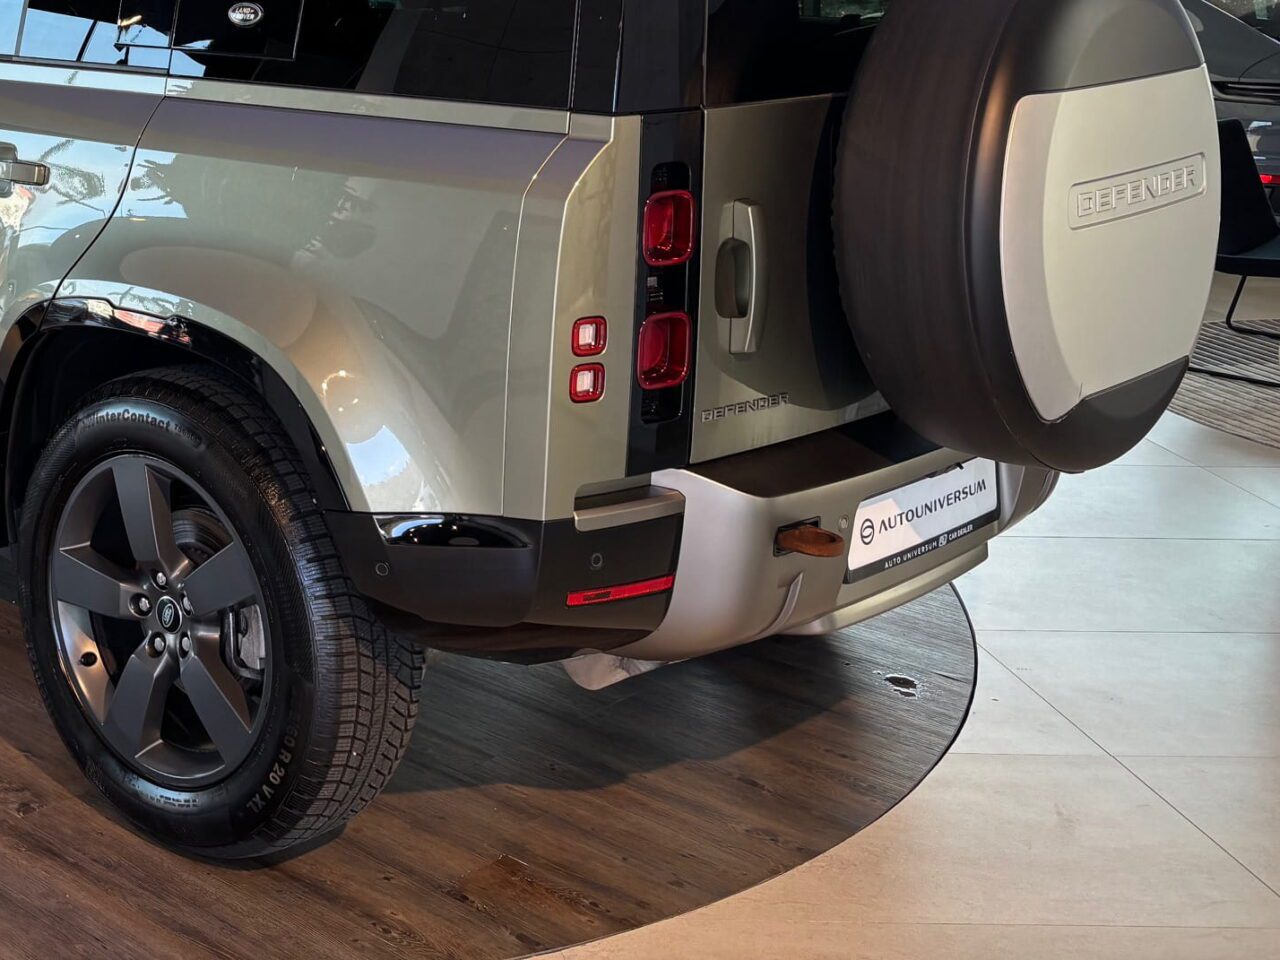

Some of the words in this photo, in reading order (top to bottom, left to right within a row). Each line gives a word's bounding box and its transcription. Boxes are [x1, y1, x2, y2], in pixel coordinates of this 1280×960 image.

[1077, 164, 1196, 218] DEFENDER
[701, 392, 789, 423] DEFENDER
[878, 478, 987, 535] AUTOUNIVERSUM
[884, 556, 901, 569] AUTO
[903, 540, 937, 561] UNIVERSUM
[948, 532, 957, 541] CAR
[957, 523, 973, 537] DEALER
[269, 762, 286, 786] 20
